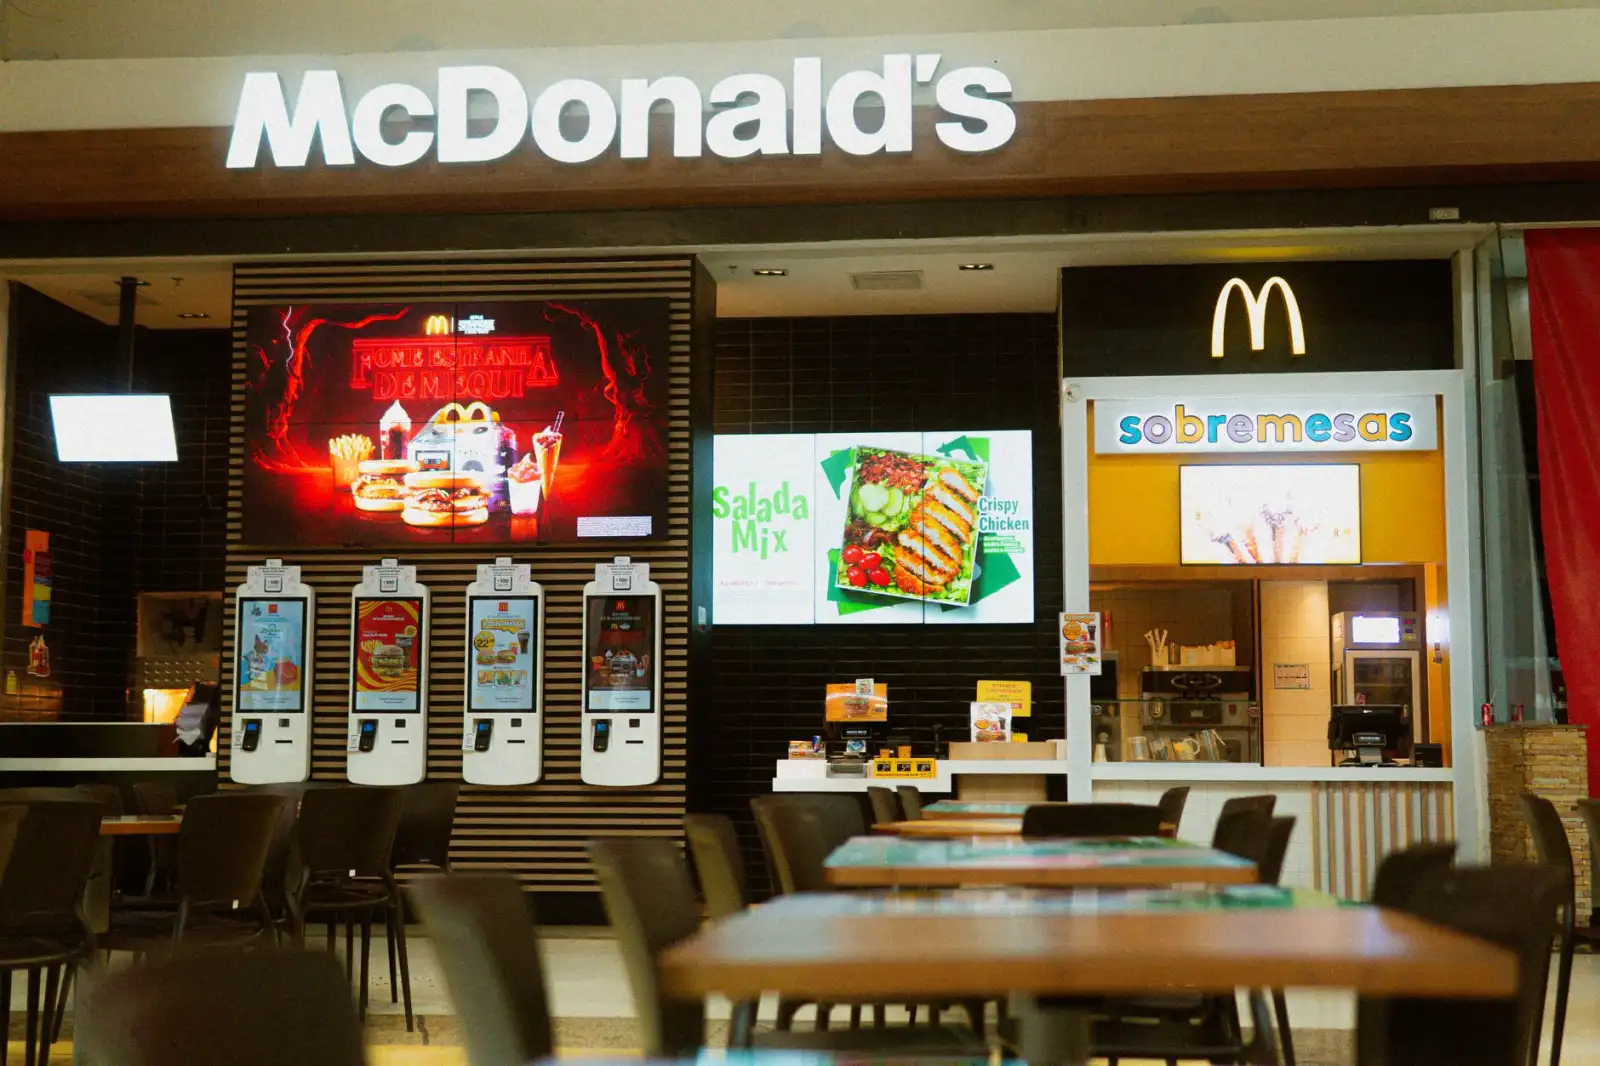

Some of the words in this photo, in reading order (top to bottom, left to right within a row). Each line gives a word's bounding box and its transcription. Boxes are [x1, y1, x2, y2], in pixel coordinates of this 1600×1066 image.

[225, 53, 1017, 168] McDonald's
[1119, 404, 1413, 446] sobremesas
[713, 481, 809, 523] Salada
[979, 496, 1018, 515] Crispy
[731, 519, 788, 559] Mix
[979, 516, 1029, 531] Chicken
